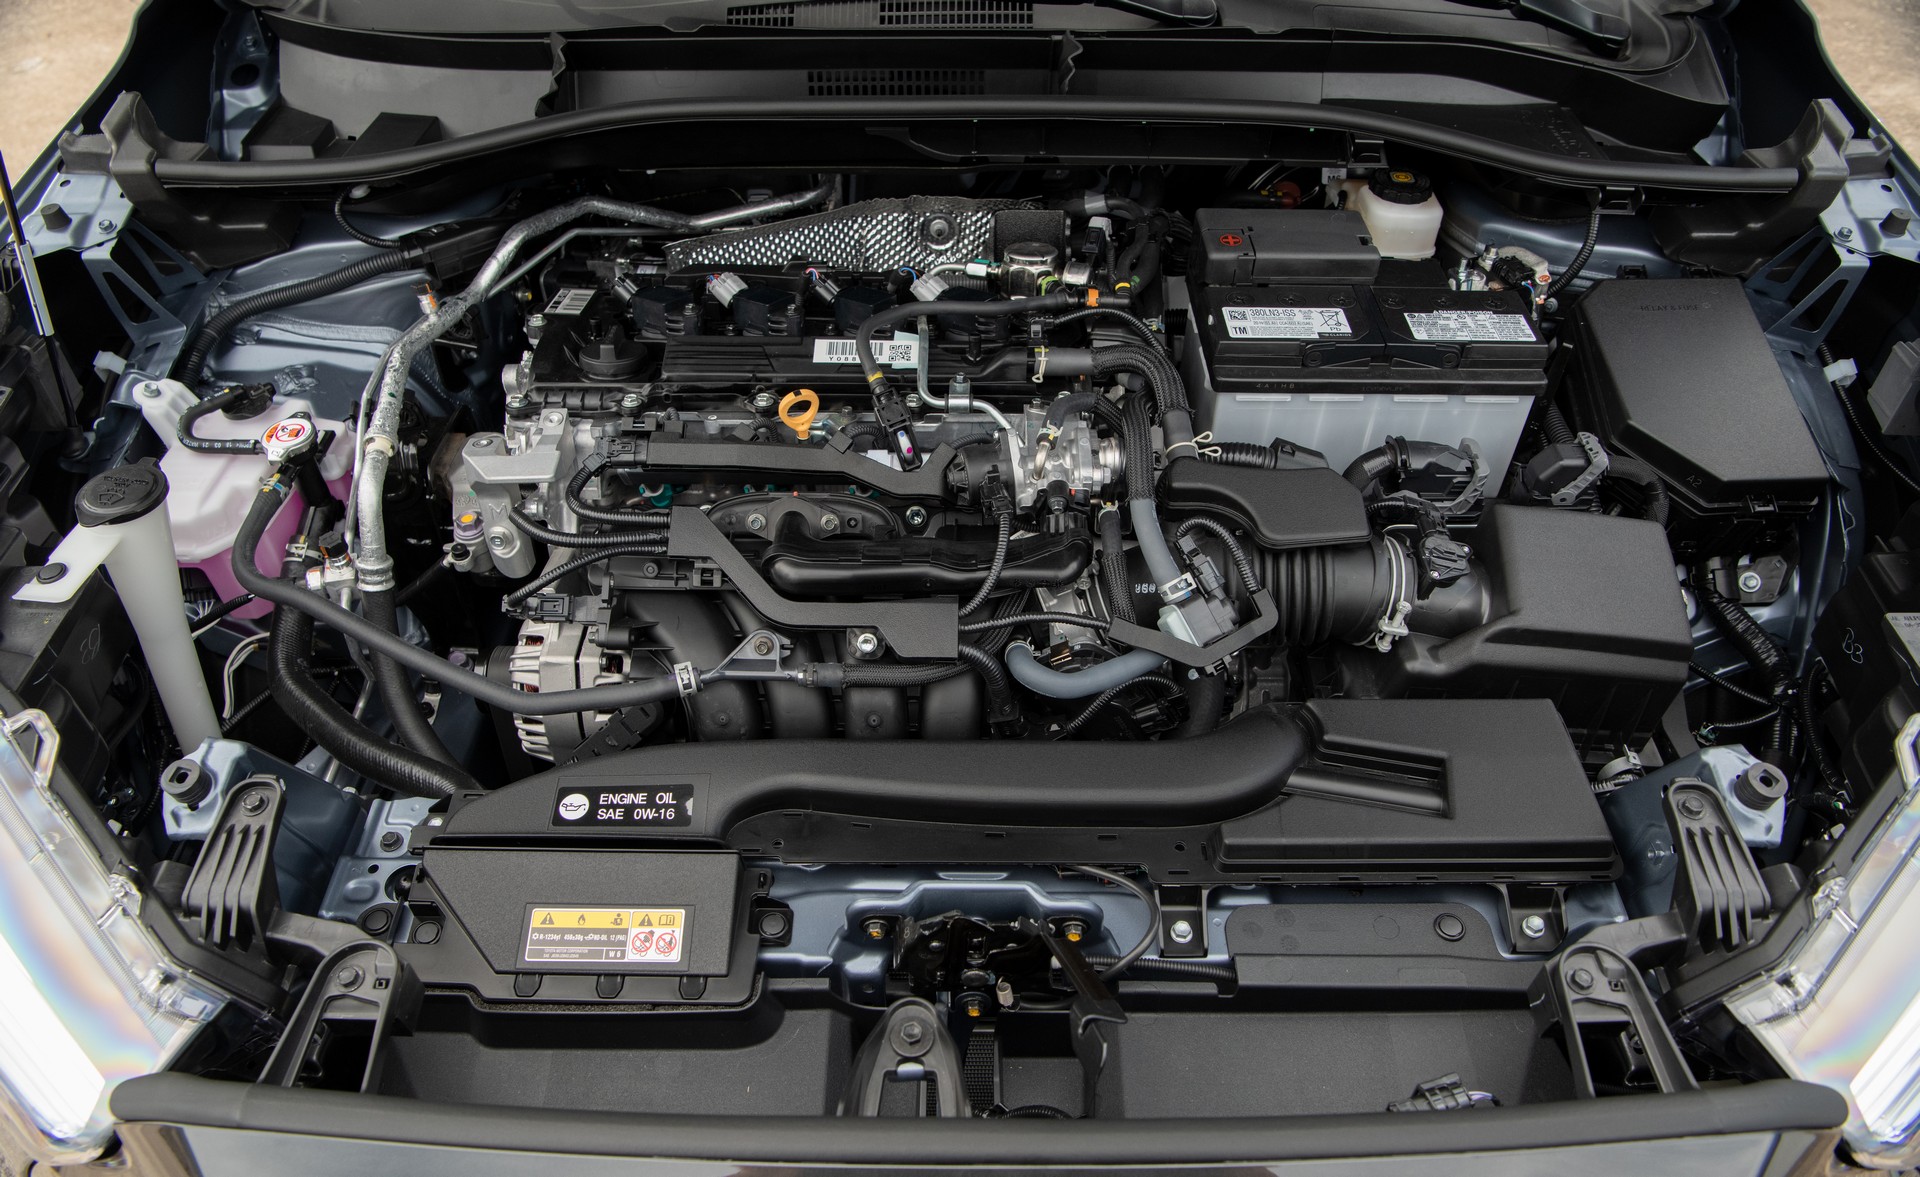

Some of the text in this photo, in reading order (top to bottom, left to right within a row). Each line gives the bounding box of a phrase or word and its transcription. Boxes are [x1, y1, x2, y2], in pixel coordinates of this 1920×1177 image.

[1249, 309, 1297, 317] 380LN3-ISS
[1232, 326, 1248, 335] TM
[1686, 475, 1703, 489] A2
[1842, 627, 1864, 664] B3
[599, 793, 678, 806] ENGINE OIL
[597, 808, 676, 821] SAE 0W-16
[540, 933, 561, 942] R-1234yf
